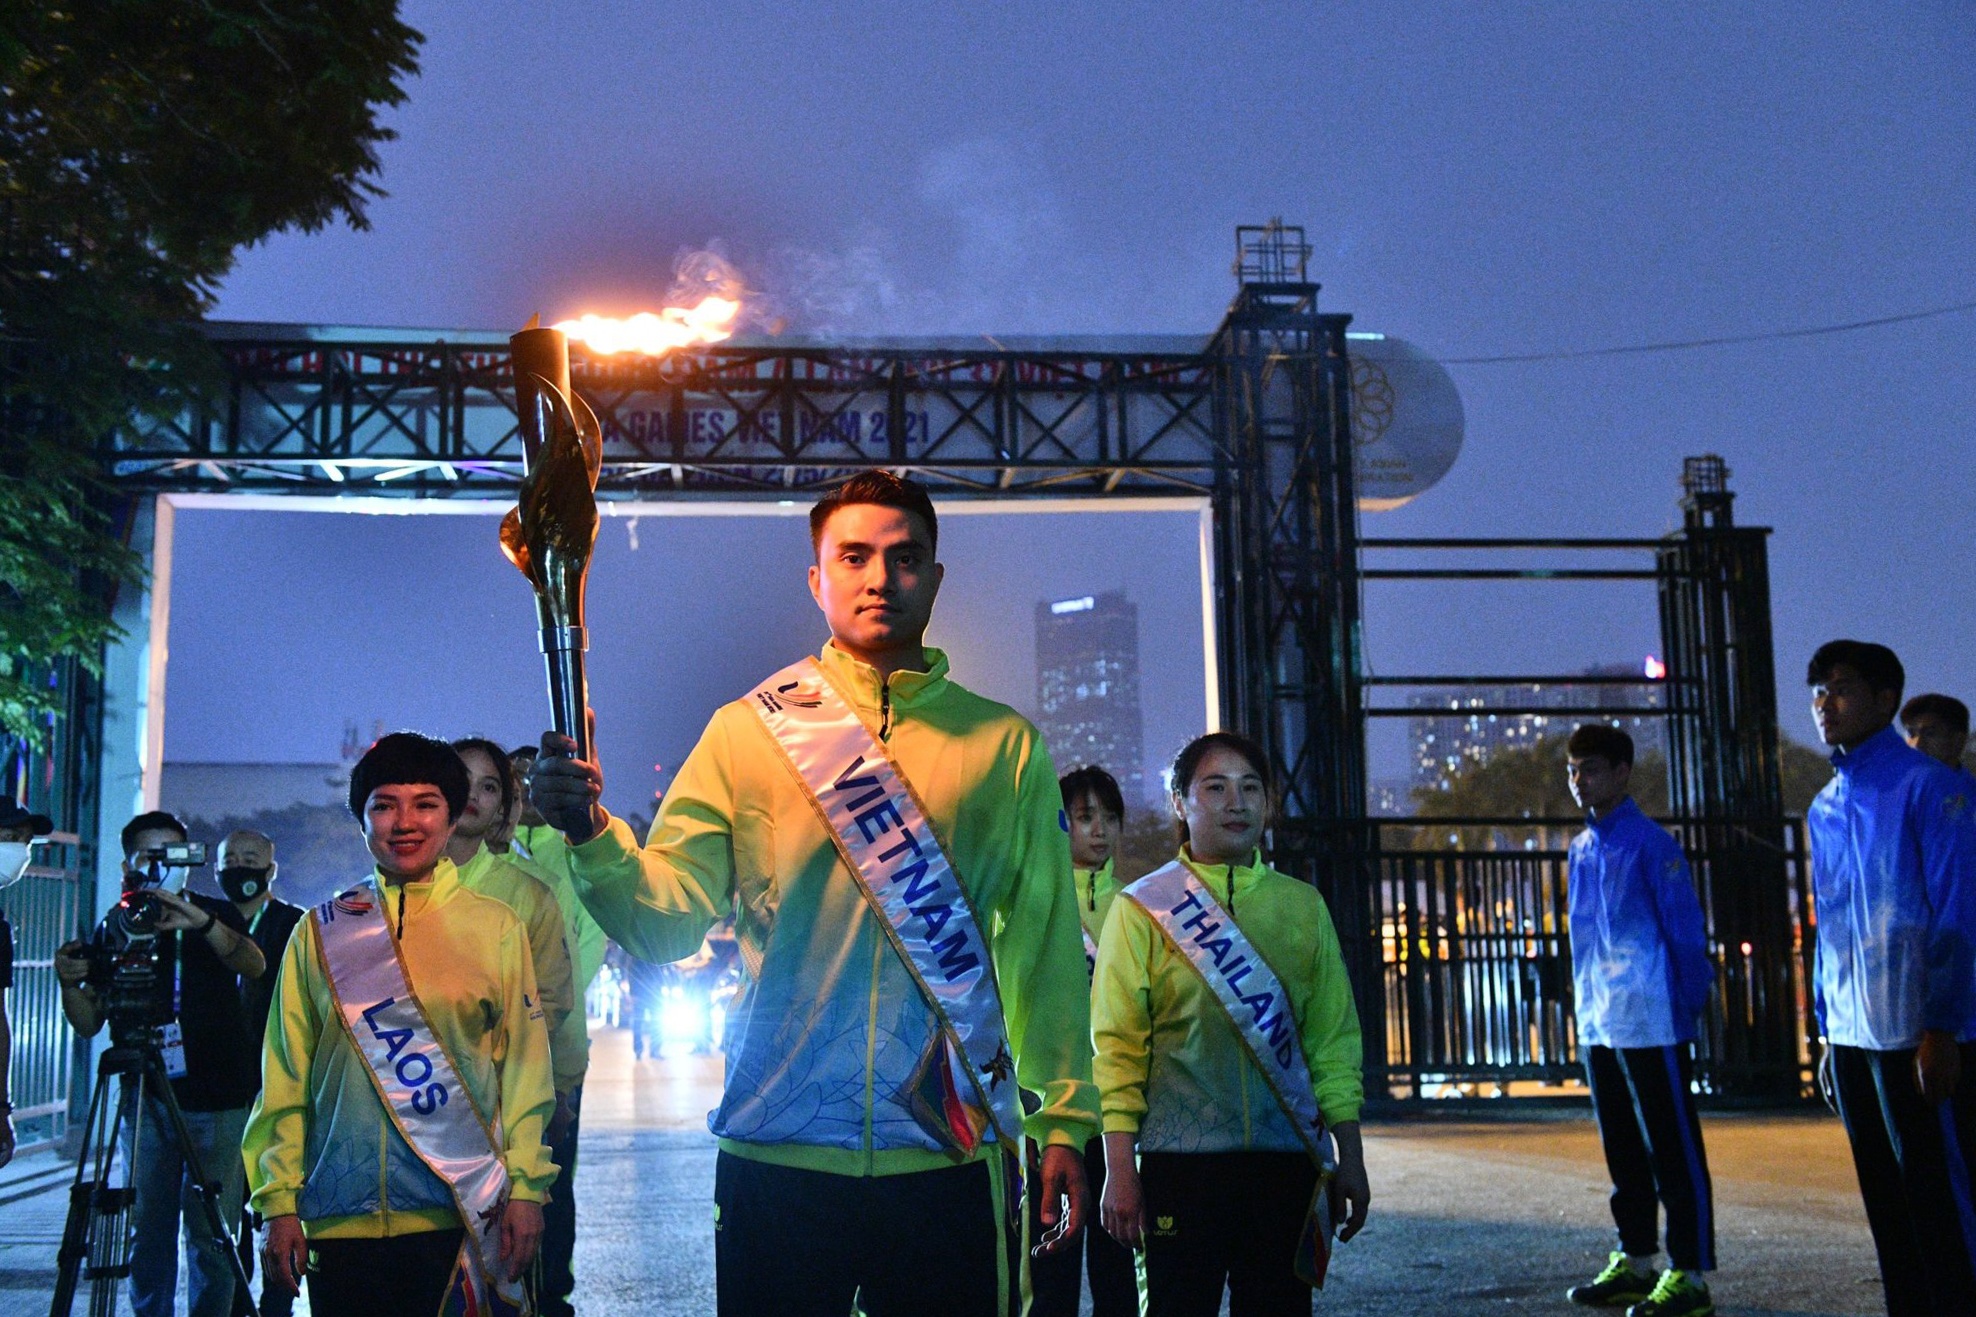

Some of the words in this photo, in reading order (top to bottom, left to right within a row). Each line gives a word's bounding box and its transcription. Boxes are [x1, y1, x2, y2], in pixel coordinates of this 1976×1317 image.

[832, 755, 981, 983] VIETNAM
[361, 995, 449, 1117] LAOS
[1169, 889, 1293, 1070] THAILAND
